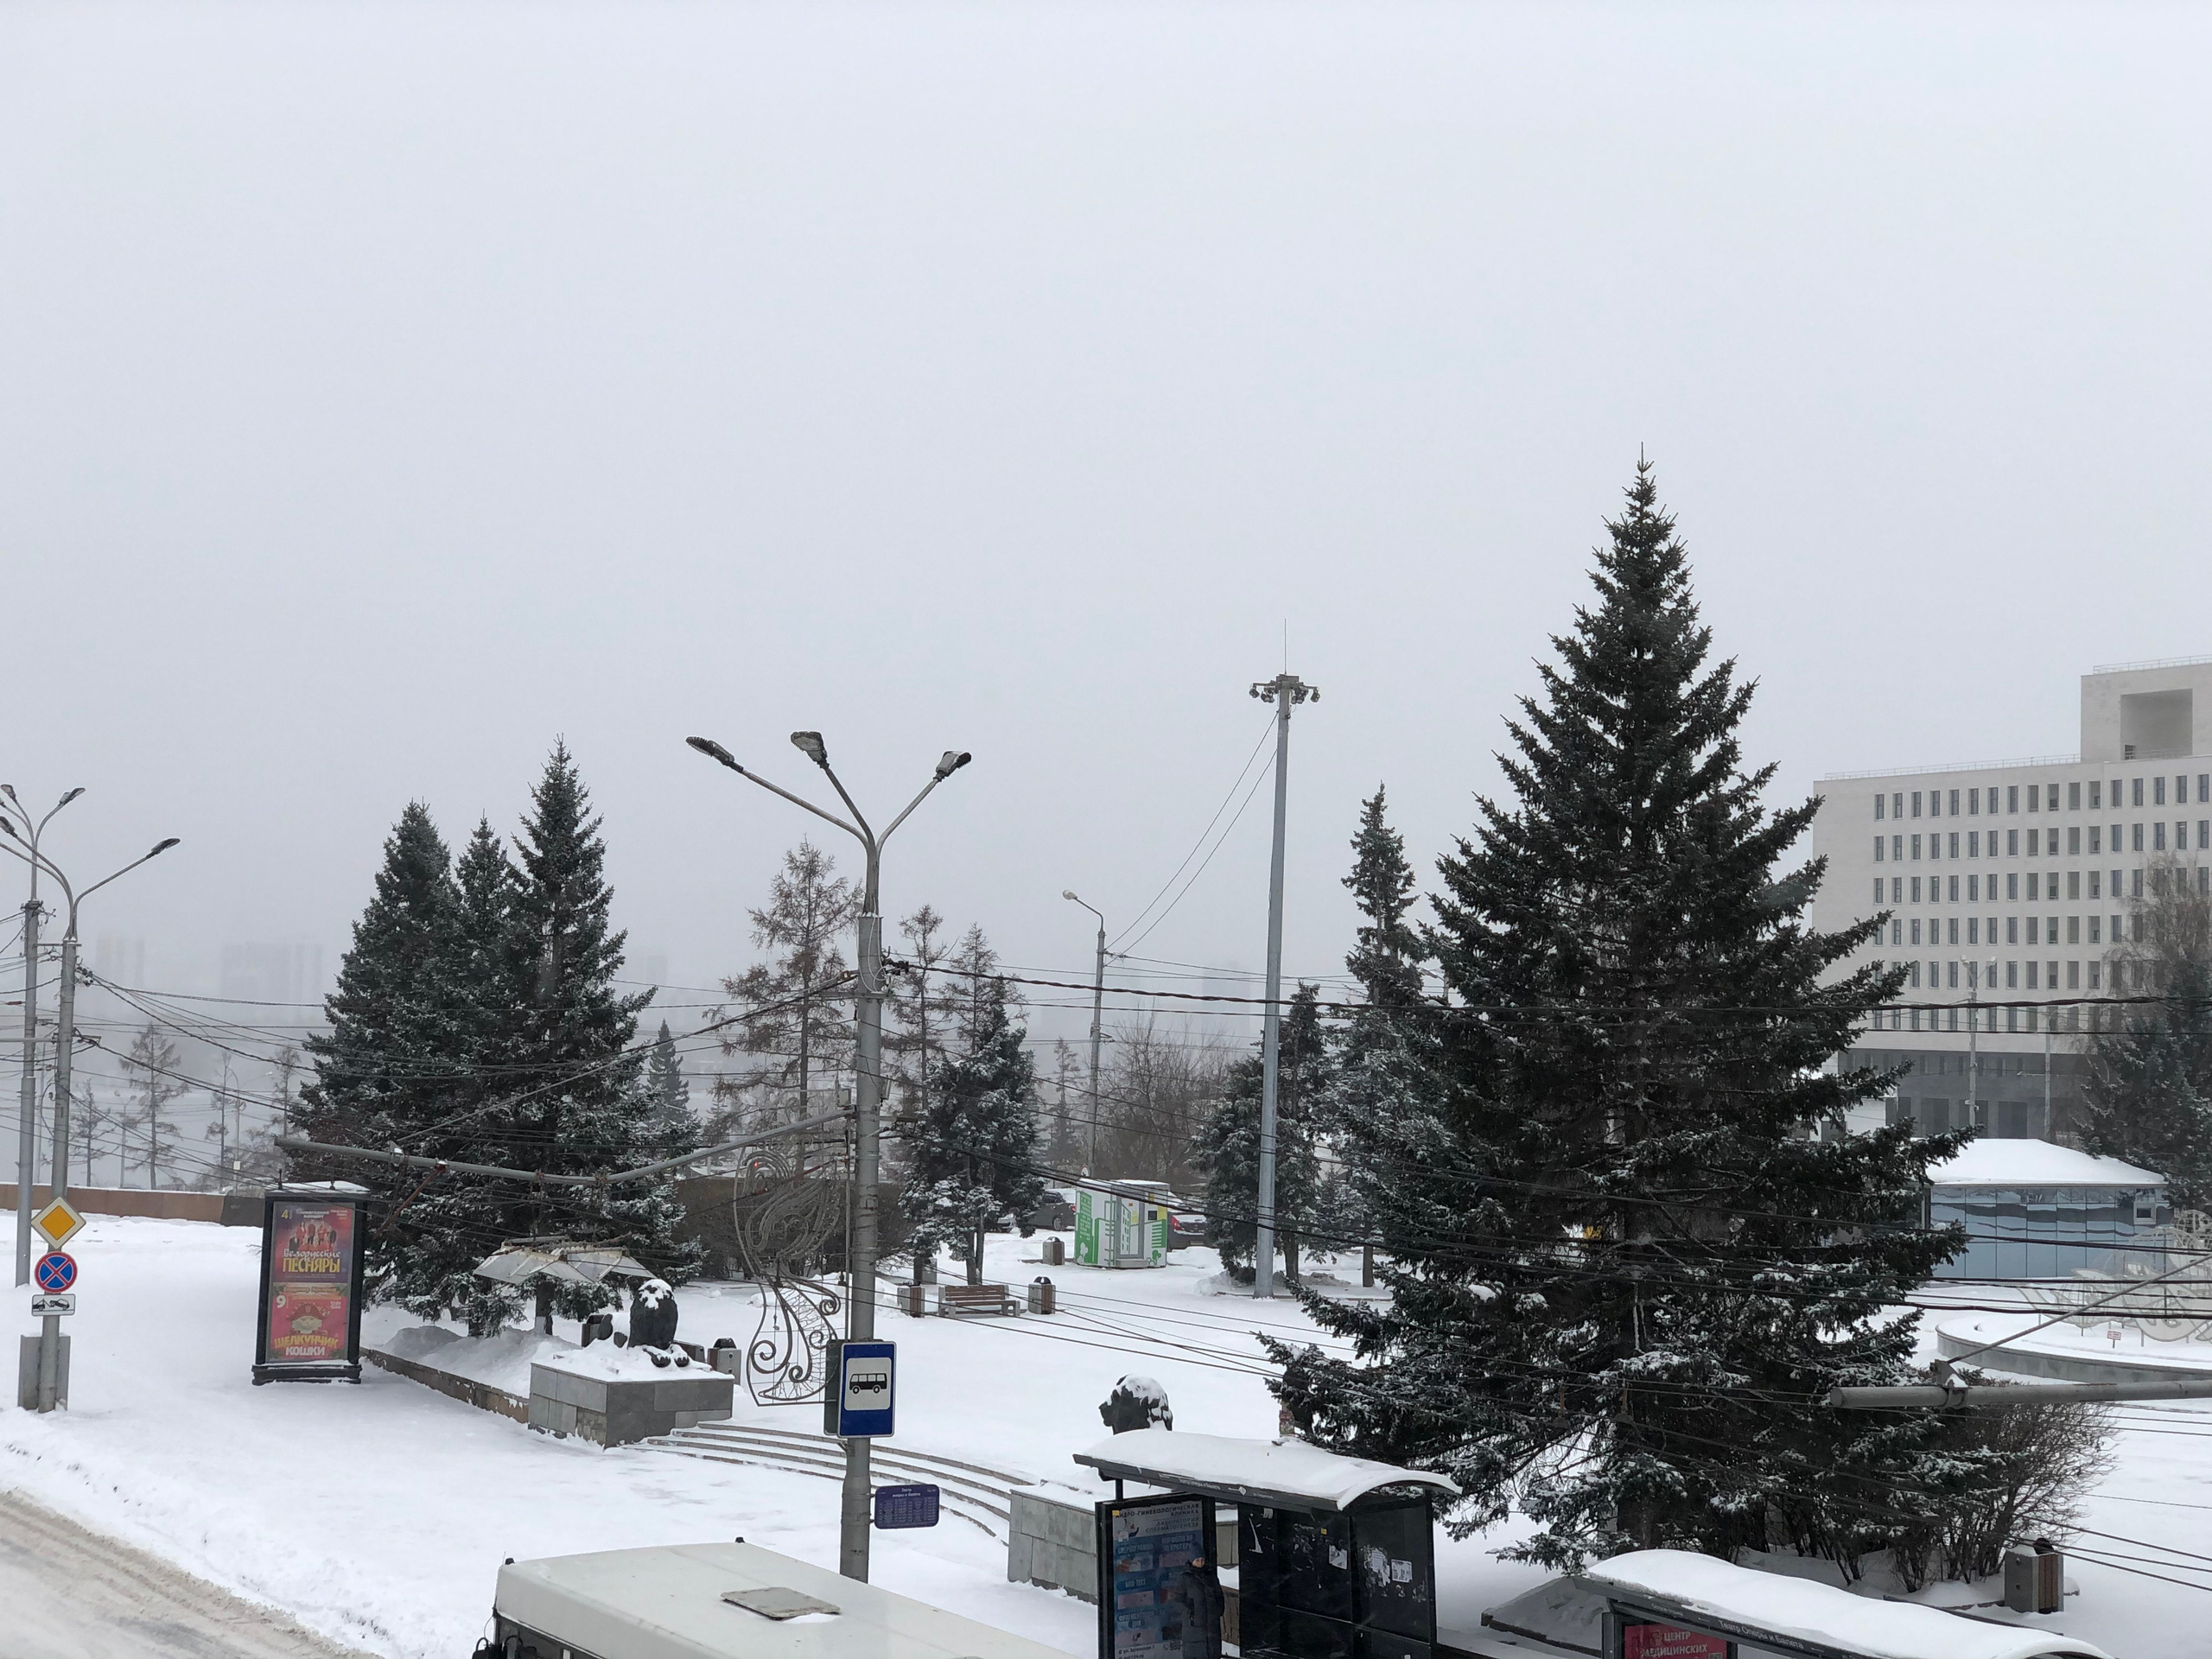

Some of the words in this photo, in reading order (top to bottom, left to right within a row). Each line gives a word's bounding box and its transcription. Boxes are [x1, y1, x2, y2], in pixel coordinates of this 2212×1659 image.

[281, 1210, 289, 1219] 4
[283, 1248, 341, 1262] Белорусские
[283, 1257, 340, 1273] ПЕСНЯРЫ
[276, 1295, 287, 1309] 9
[285, 1346, 326, 1356] КОШКИ
[1145, 1522, 1199, 1533] СПЕРМАТОГЕНЕЗА
[1156, 1516, 1199, 1527] ЛАБОРАТОРИЯ
[1663, 1631, 1691, 1642] ЦЕНТР
[1718, 1619, 1741, 1634] Театр
[1741, 1626, 1768, 1641] Оперы
[1775, 1635, 1804, 1649] Балета
[1642, 1644, 1707, 1658] МЕДИЦИНСКИХ
